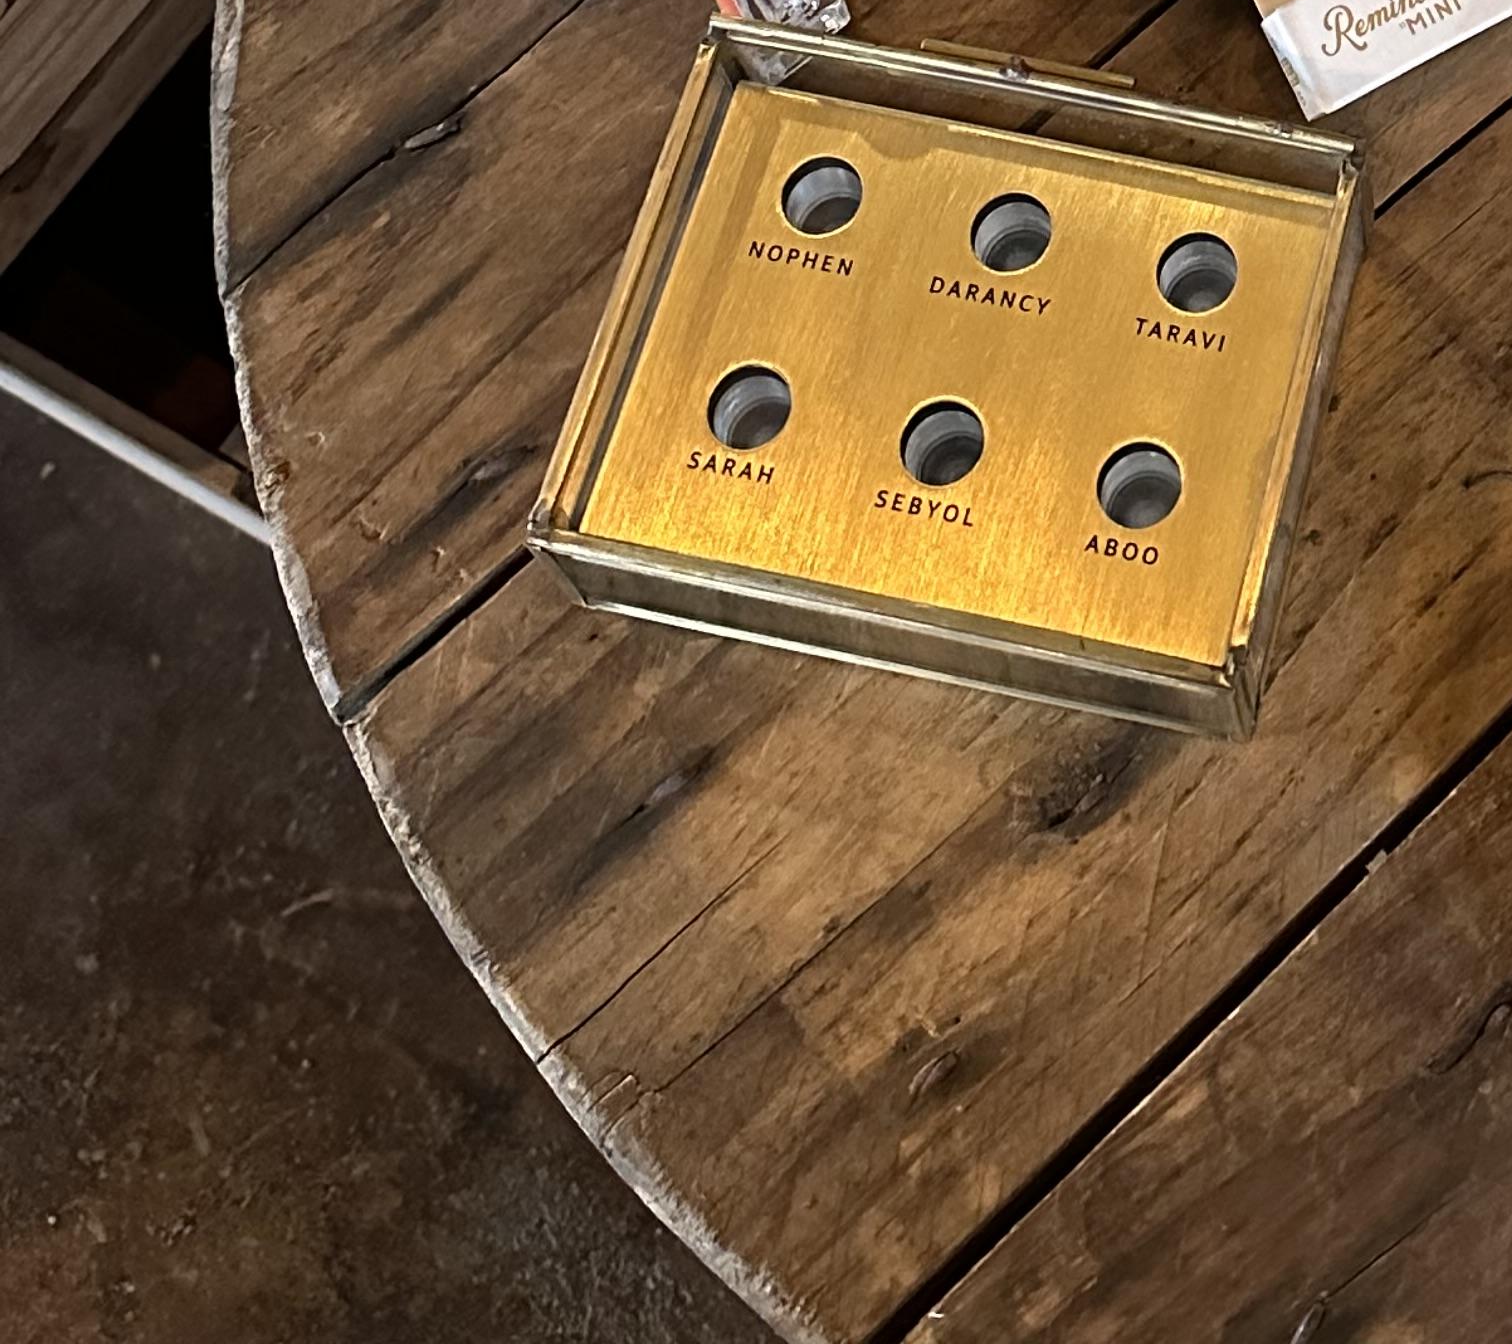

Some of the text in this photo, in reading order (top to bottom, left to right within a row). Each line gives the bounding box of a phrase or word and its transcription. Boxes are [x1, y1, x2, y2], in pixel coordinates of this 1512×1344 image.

[748, 241, 854, 276] NOPHEN
[929, 276, 1052, 315] DARANCY
[1136, 318, 1228, 352] TARAVI
[687, 451, 775, 485] SARAH
[874, 491, 976, 527] SEBYOL
[1085, 536, 1159, 566] ABOO
